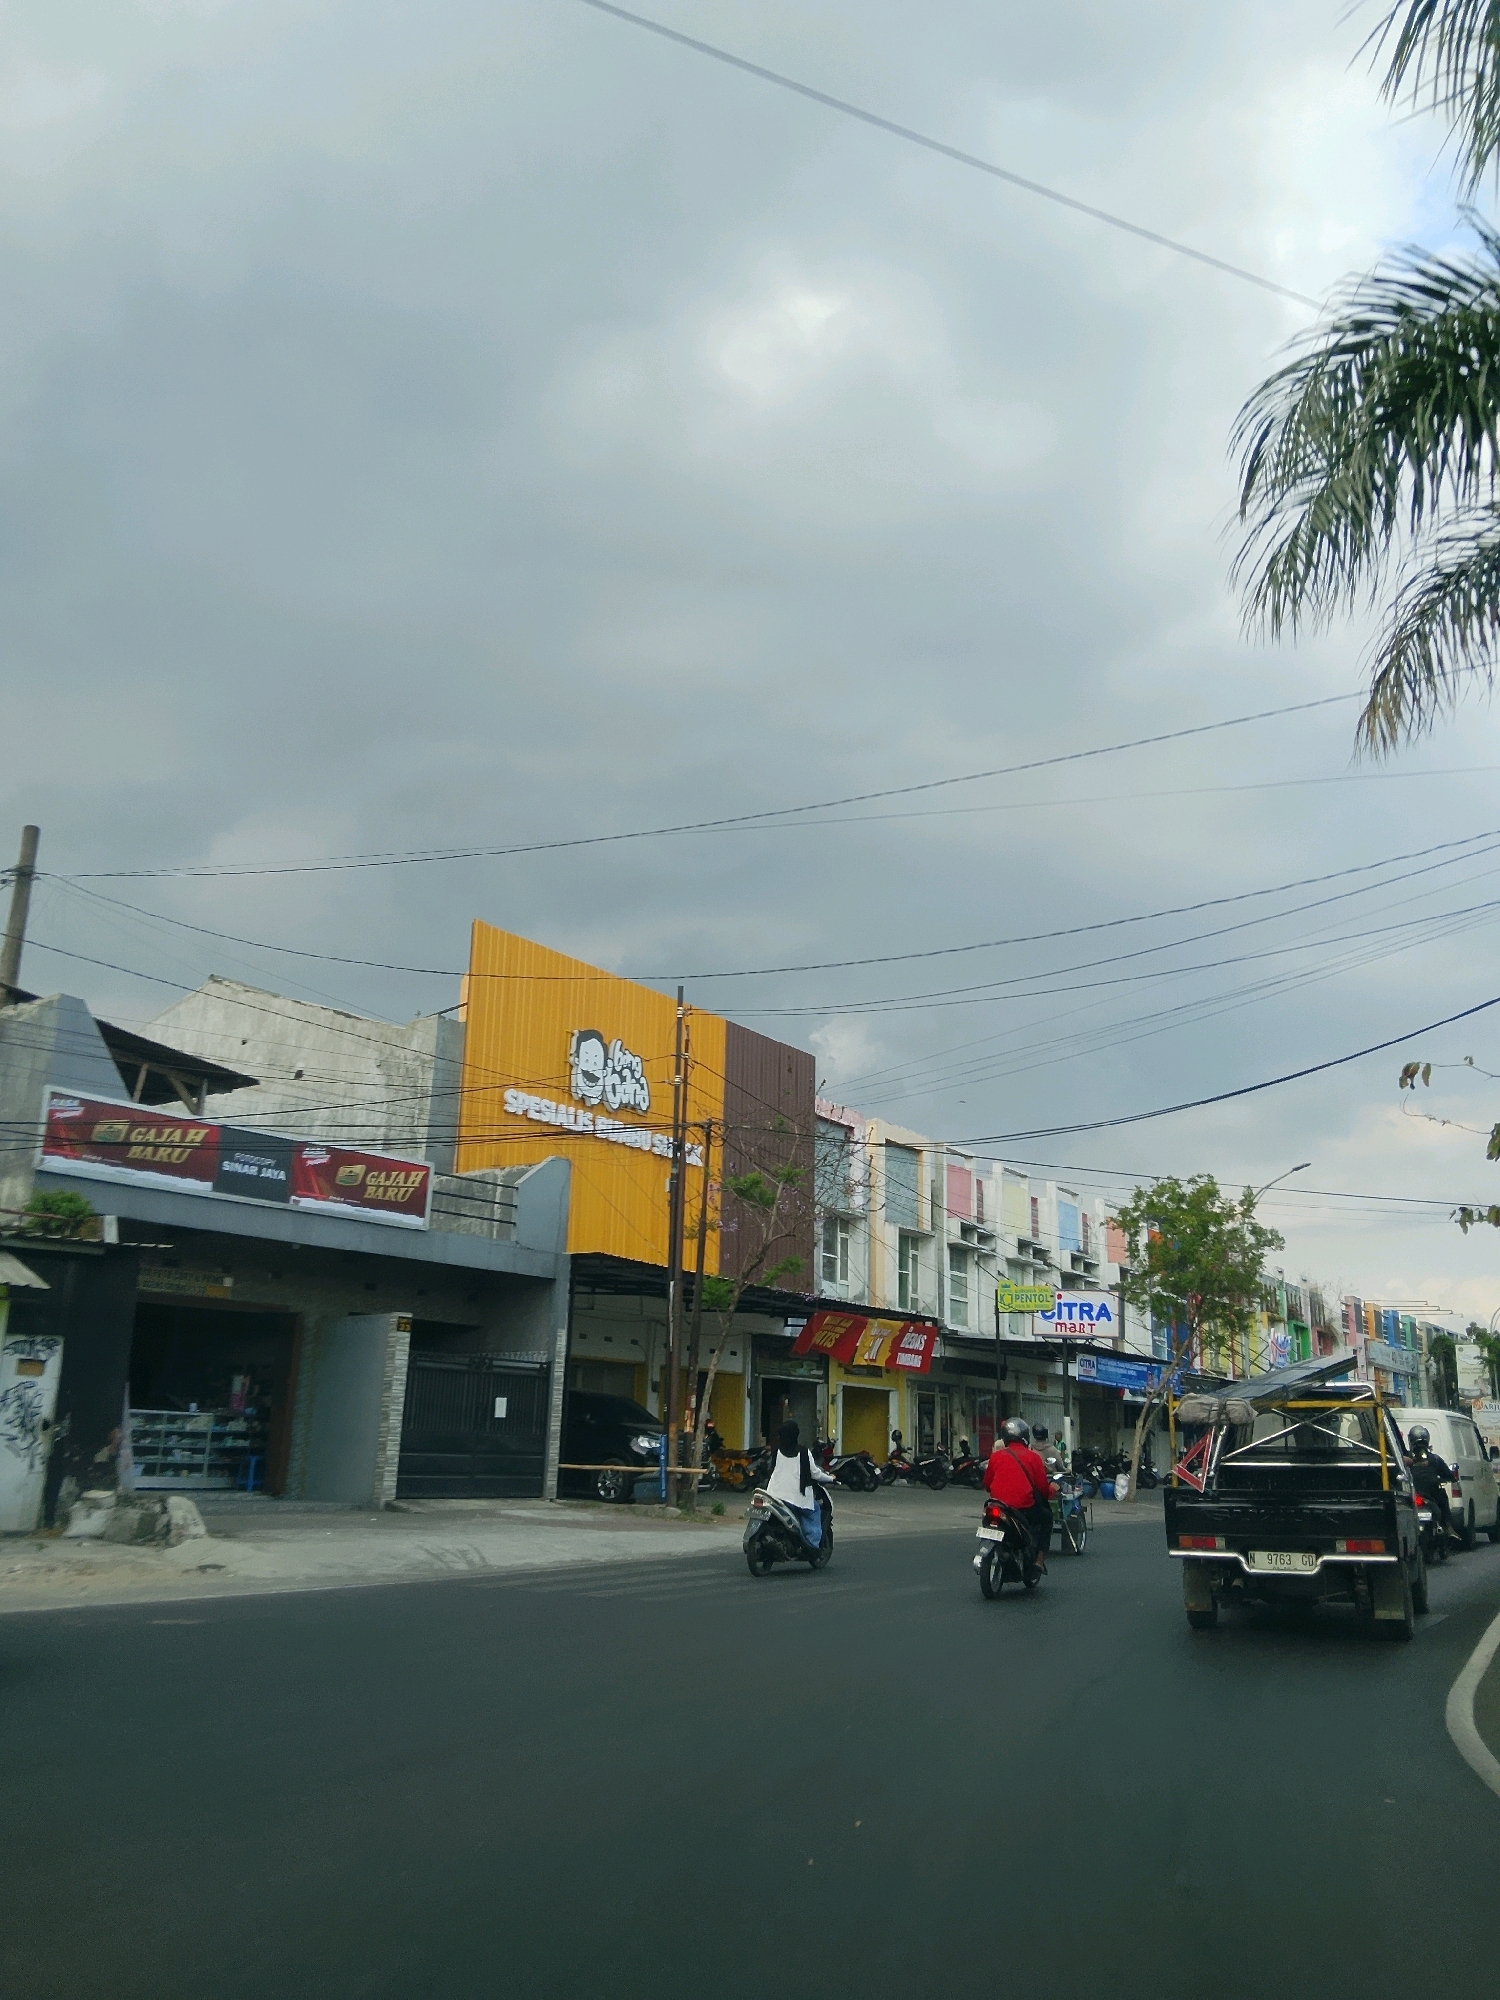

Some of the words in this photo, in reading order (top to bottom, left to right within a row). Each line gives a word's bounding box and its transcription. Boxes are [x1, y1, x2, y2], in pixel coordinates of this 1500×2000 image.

[503, 1088, 594, 1133] SPESIALIS
[130, 1127, 210, 1143] GAJAH
[126, 1145, 193, 1164] BARU
[234, 1152, 277, 1167] FOTOCOPY
[222, 1160, 258, 1176] SINAR
[259, 1167, 287, 1181] JAYA
[365, 1170, 427, 1187] GAJAH
[363, 1186, 415, 1203] BARU
[1014, 1293, 1051, 1304] PENTOL
[1249, 1553, 1257, 1565] N
[1266, 1553, 1292, 1566] 9763
[1301, 1555, 1315, 1567] GD
